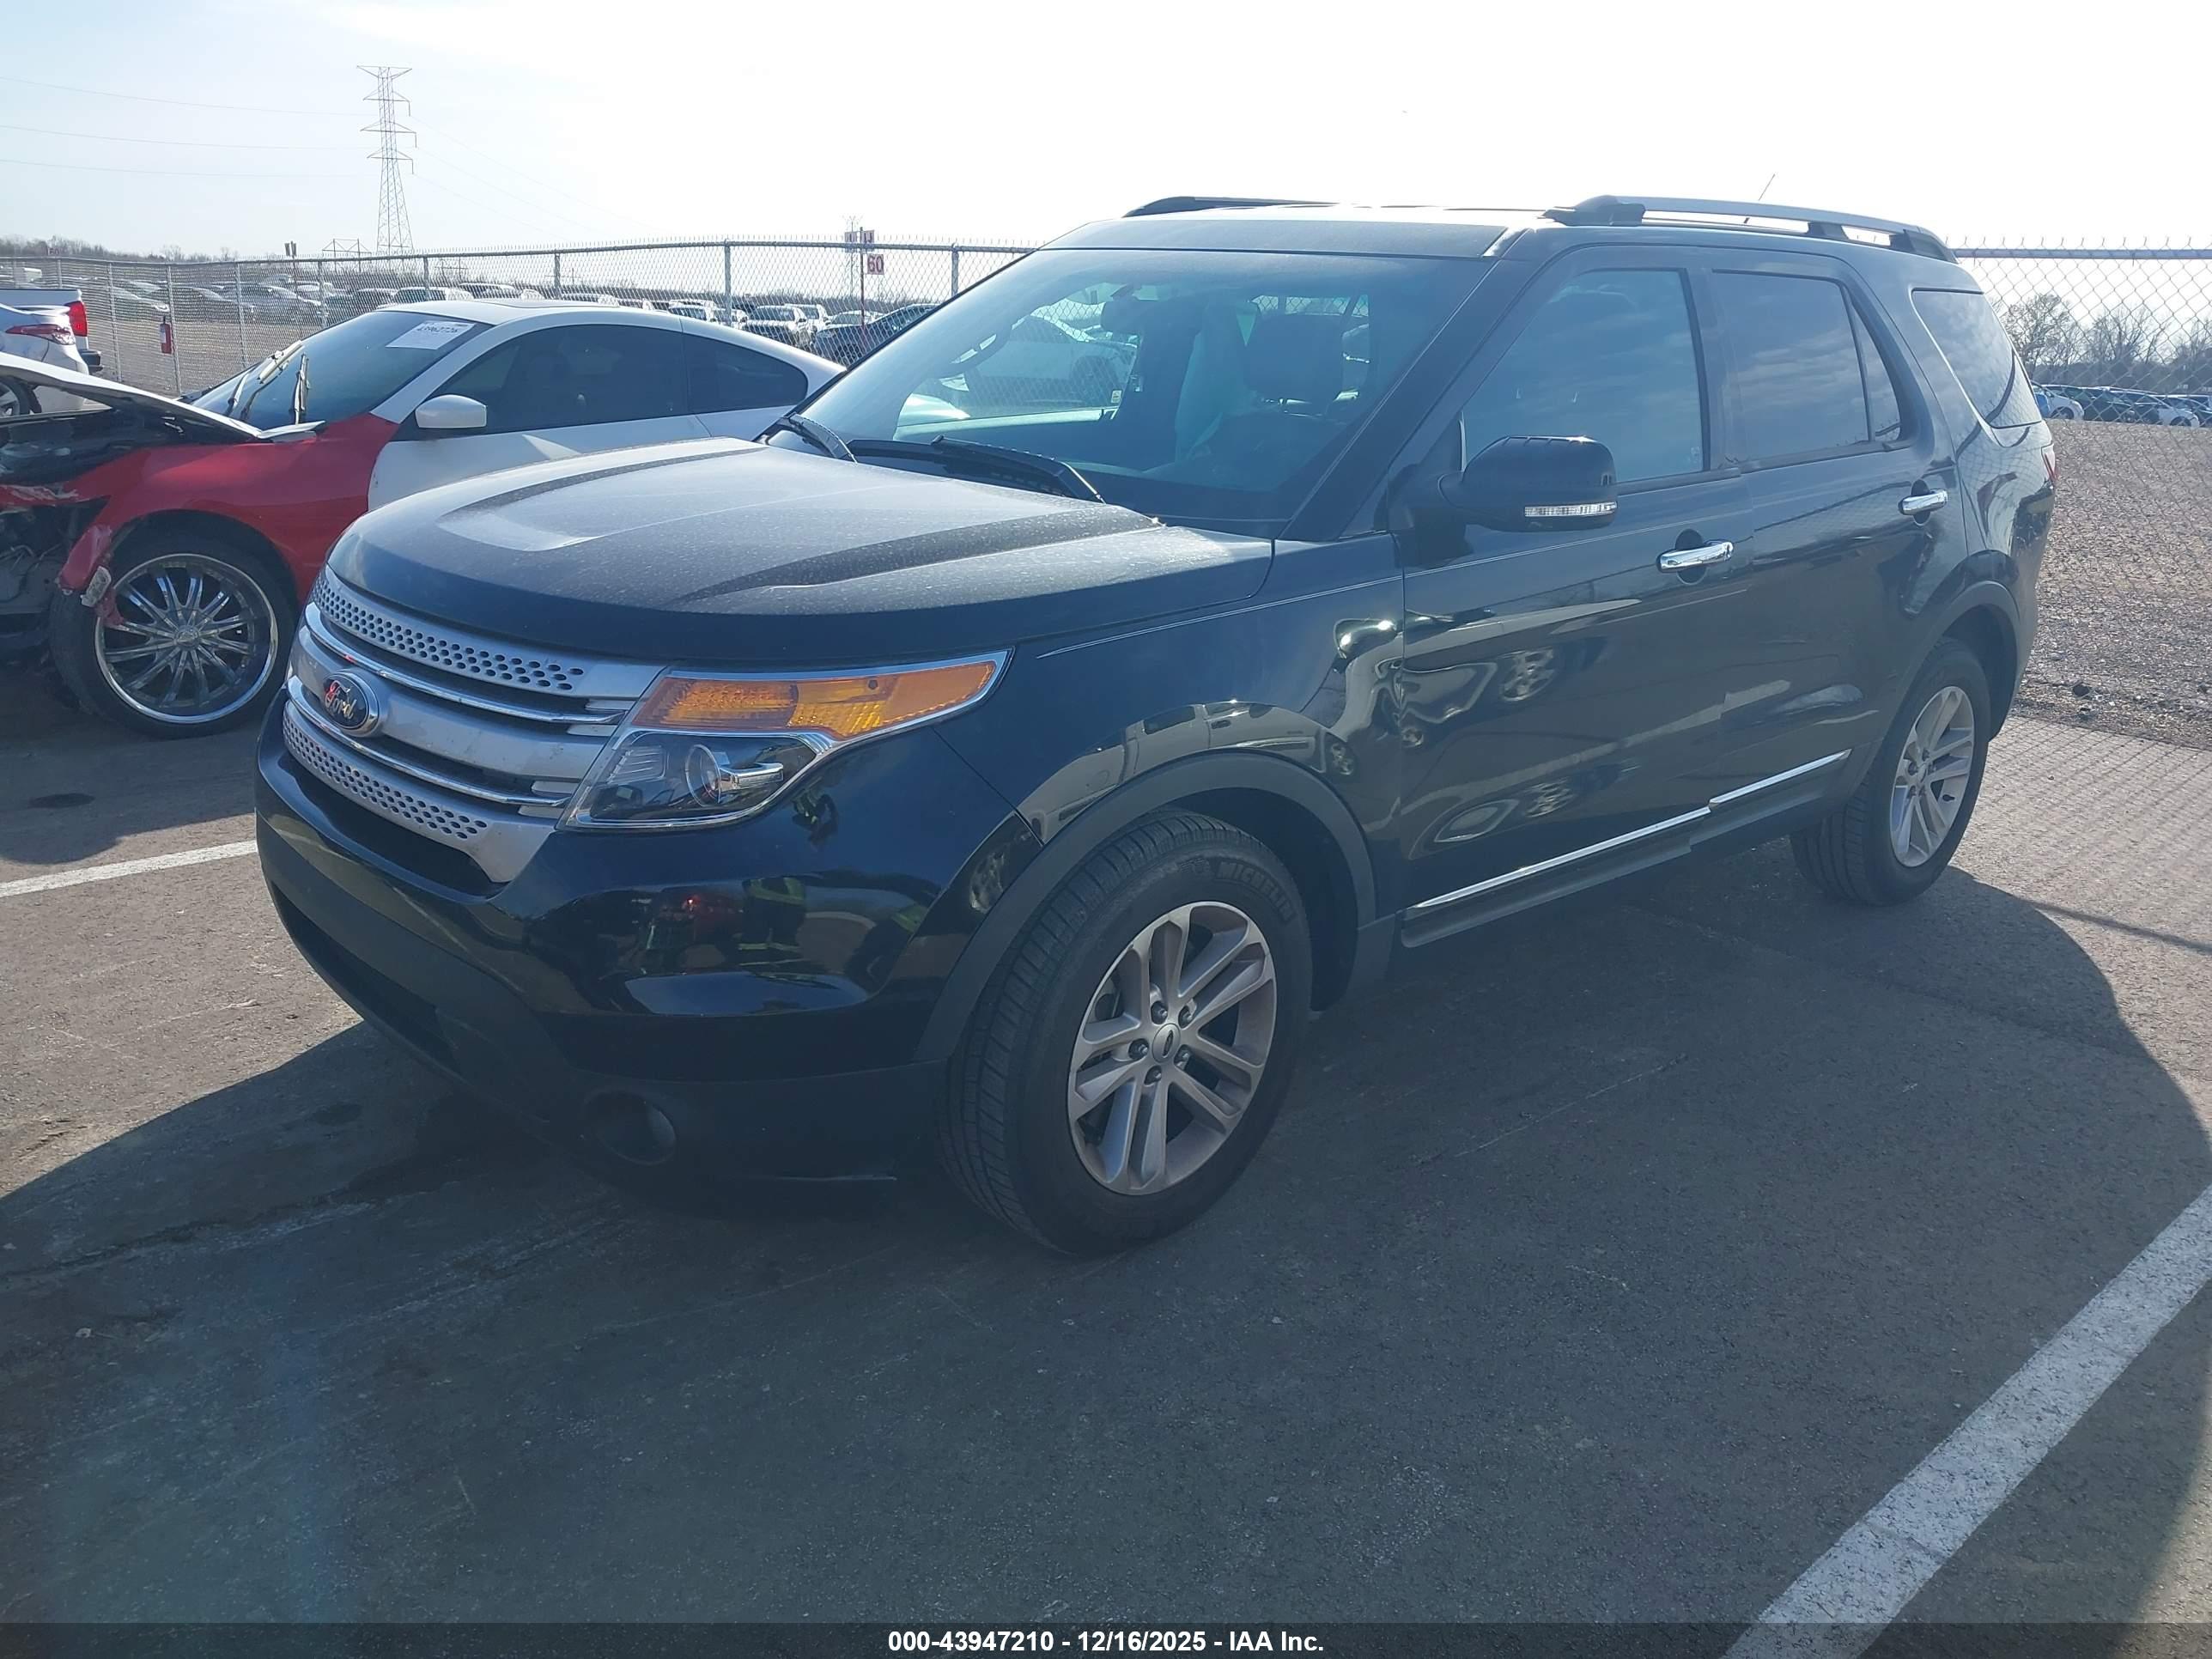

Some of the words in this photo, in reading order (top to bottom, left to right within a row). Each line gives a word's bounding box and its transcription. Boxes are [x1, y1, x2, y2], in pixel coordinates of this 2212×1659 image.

[867, 255, 884, 273] 60
[325, 680, 357, 720] Ford
[1217, 860, 1297, 922] MICHELIN
